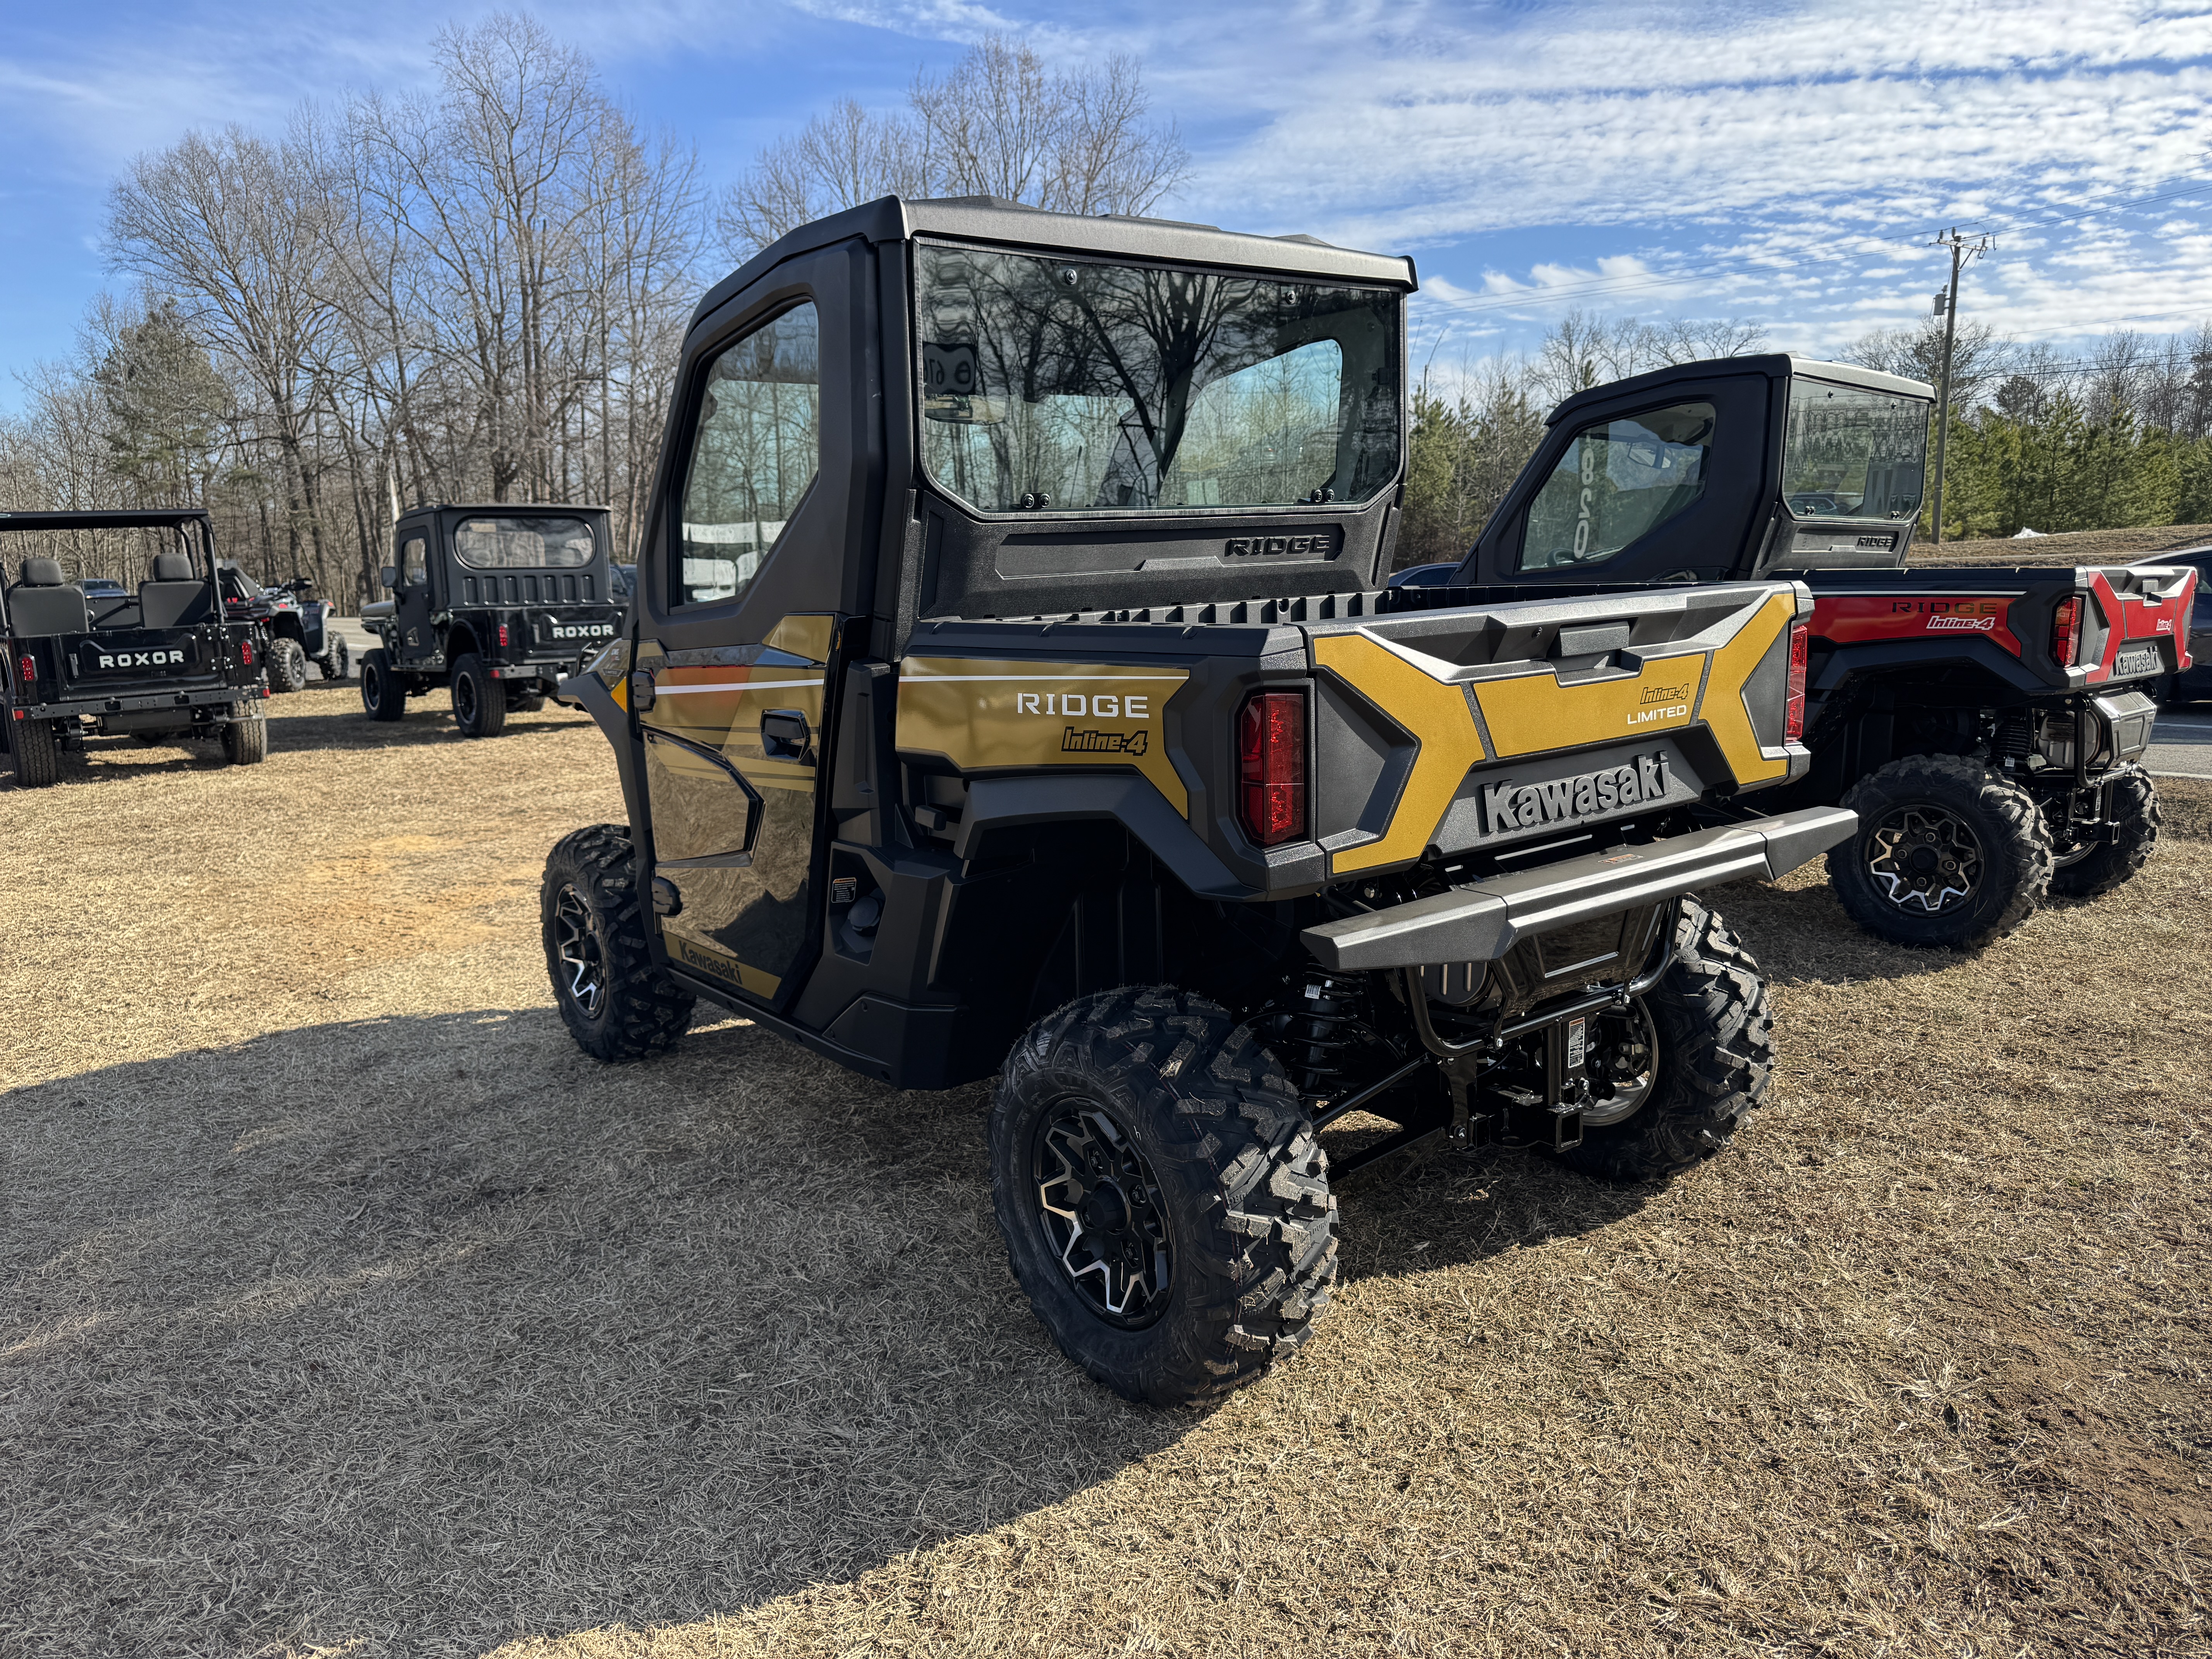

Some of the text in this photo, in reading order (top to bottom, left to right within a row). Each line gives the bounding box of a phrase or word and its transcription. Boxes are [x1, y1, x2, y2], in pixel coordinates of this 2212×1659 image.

[1224, 535, 1331, 557] RIDGE
[1857, 535, 1893, 547] RIDGE
[1892, 601, 1997, 615] RIDGE
[553, 624, 613, 639] ROXOR
[1925, 615, 1996, 630] Inline-4
[100, 650, 184, 669] ROXOR
[2113, 646, 2160, 676] Kawasaki
[1640, 683, 1689, 705] Inline-4
[1018, 692, 1149, 719] RIDGE
[1627, 704, 1687, 725] LIMITED
[1061, 726, 1148, 756] Inline-4
[1481, 750, 1672, 836] Kawasaki
[678, 939, 743, 986] Kawasaki
